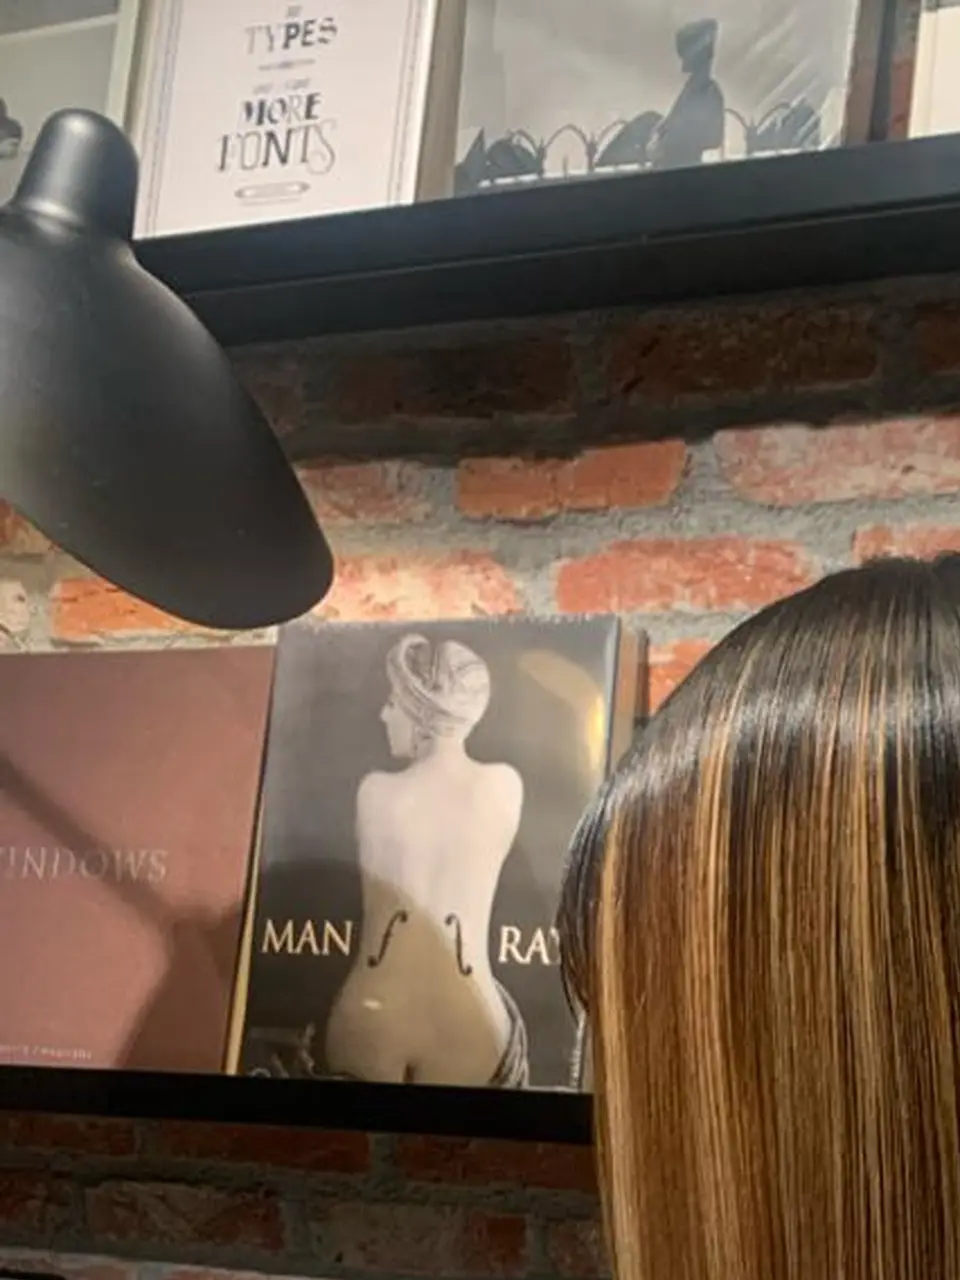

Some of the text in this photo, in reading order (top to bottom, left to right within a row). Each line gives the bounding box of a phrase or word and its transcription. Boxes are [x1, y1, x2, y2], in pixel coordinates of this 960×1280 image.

[245, 17, 337, 54] TYPES
[243, 92, 322, 126] MORE
[217, 119, 338, 175] FONTS
[0, 846, 169, 883] INDOWS
[261, 919, 354, 957] MAN
